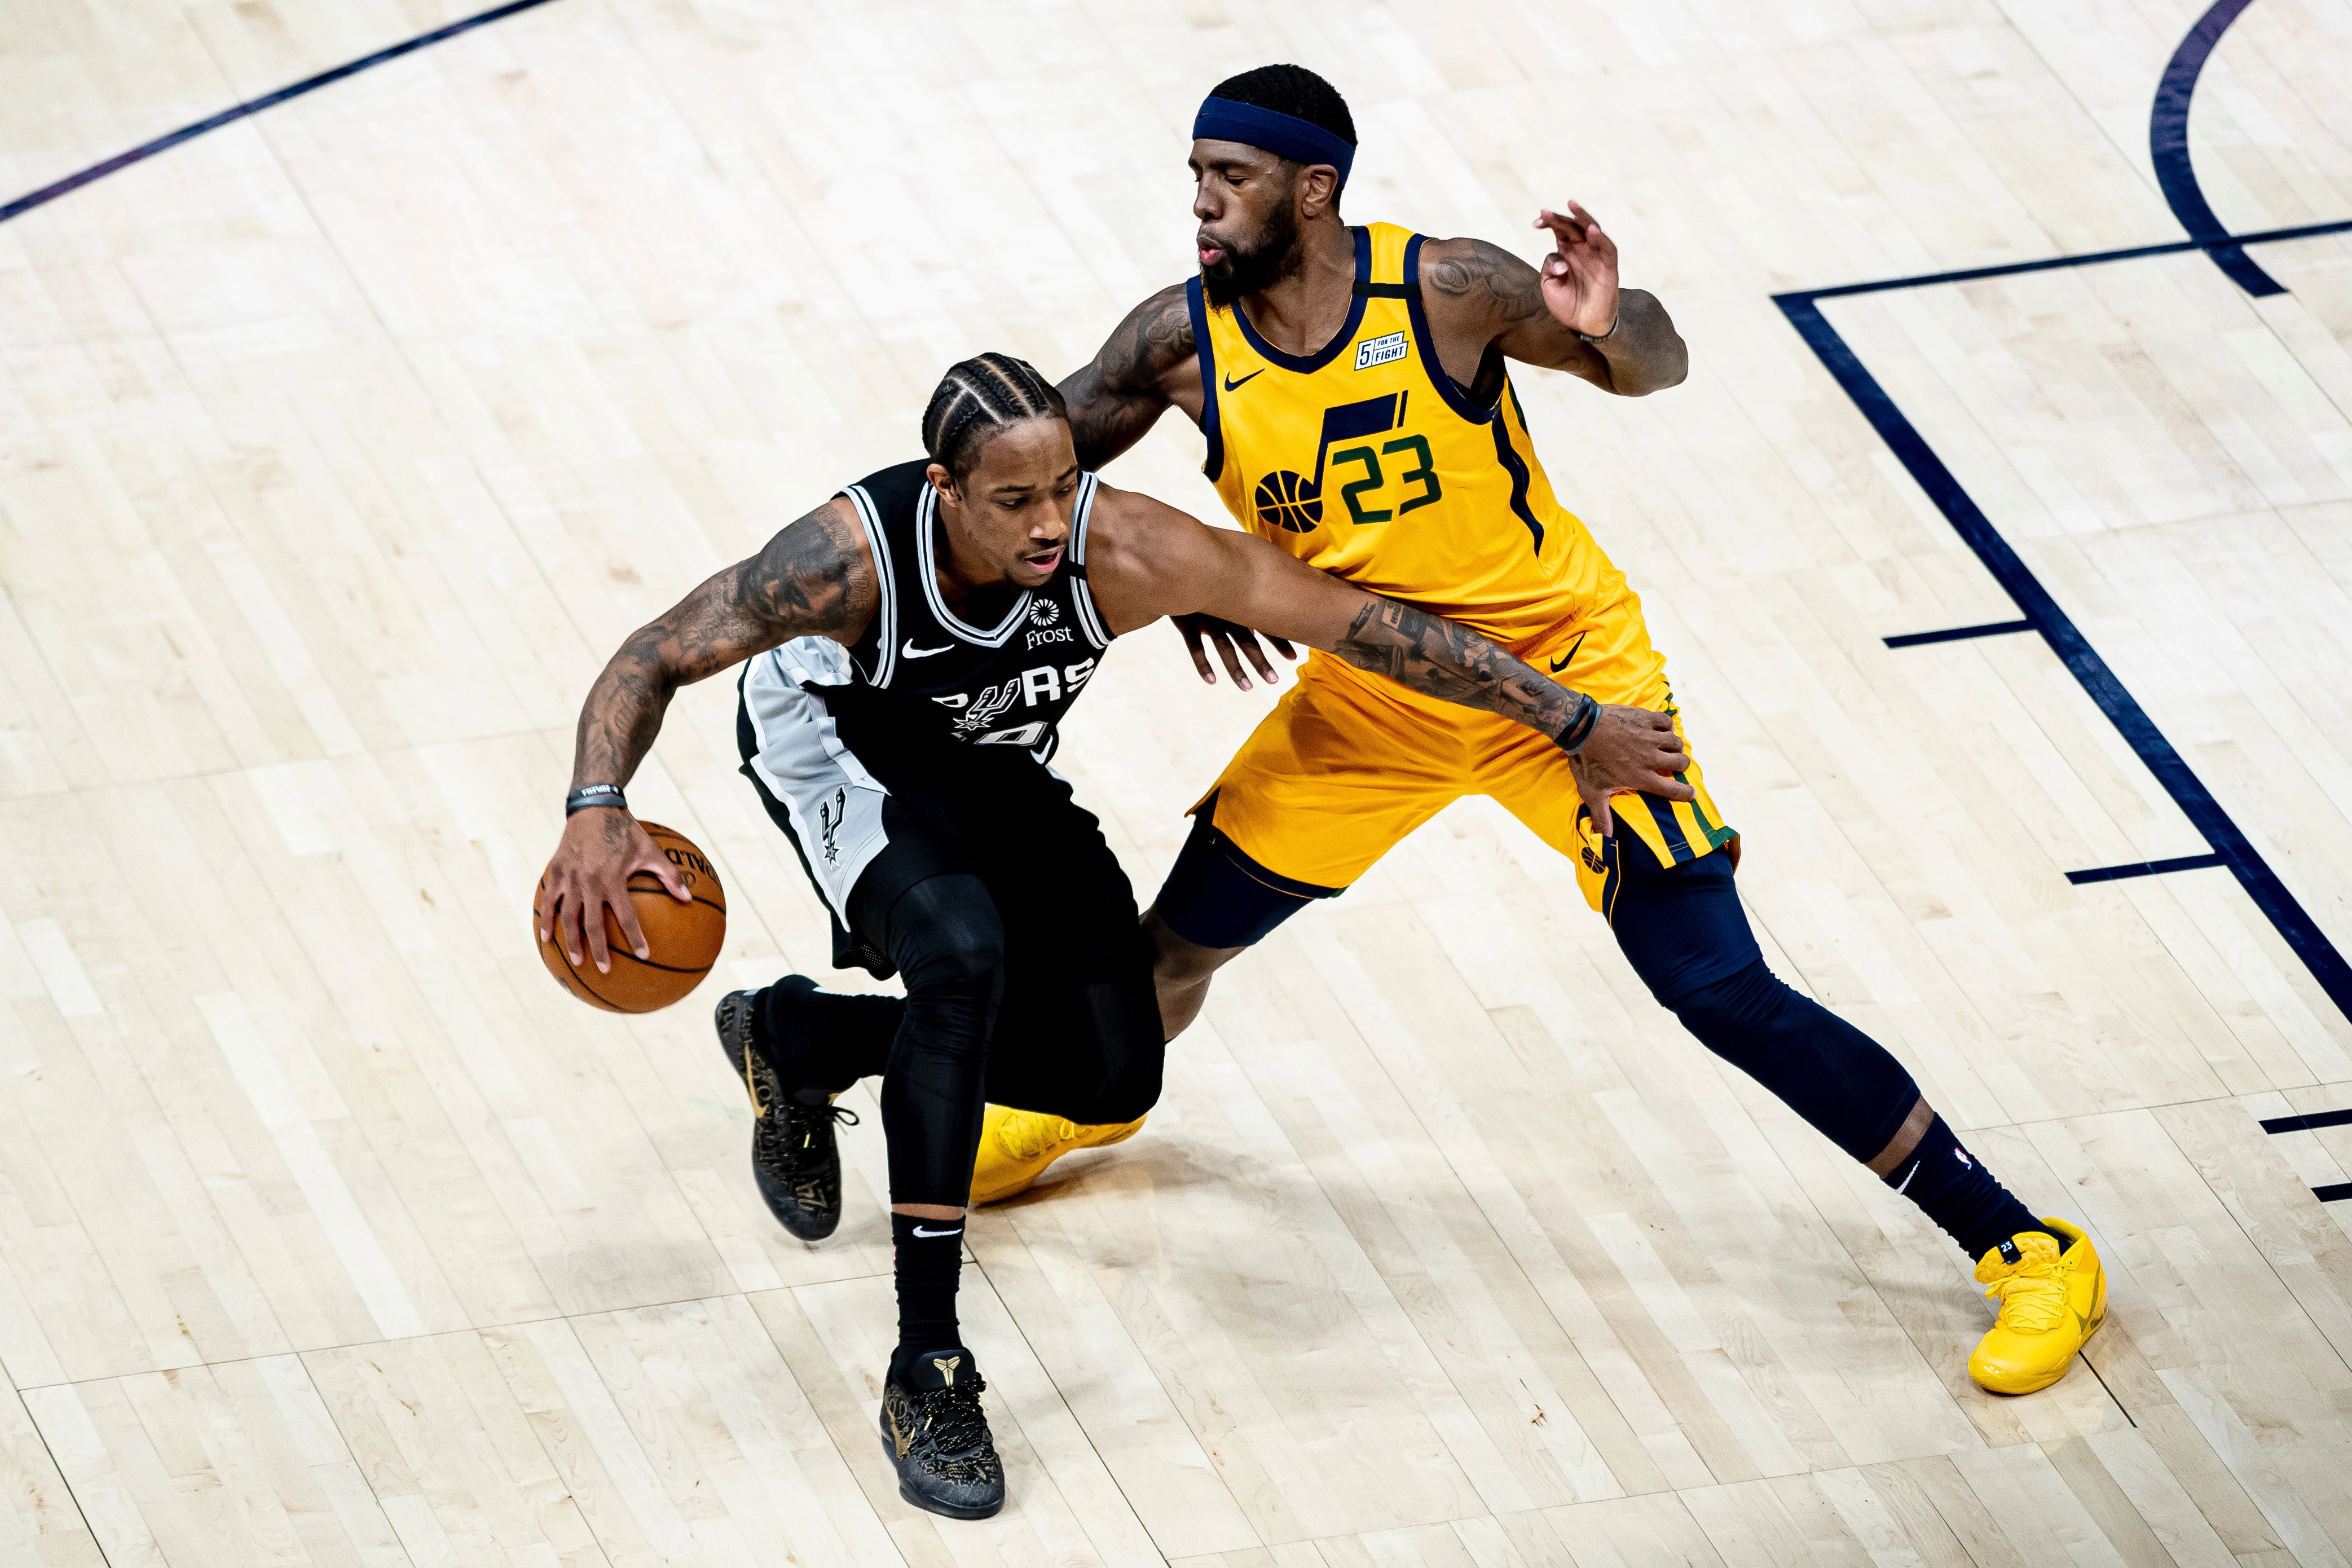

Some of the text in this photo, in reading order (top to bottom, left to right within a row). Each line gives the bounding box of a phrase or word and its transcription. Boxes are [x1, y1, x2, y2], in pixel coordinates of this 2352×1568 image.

[1359, 343, 1371, 365] 5
[1375, 346, 1404, 362] FIGHT
[1332, 434, 1442, 525] 23
[1025, 626, 1074, 651] Frost
[2001, 1241, 2012, 1253] 23
